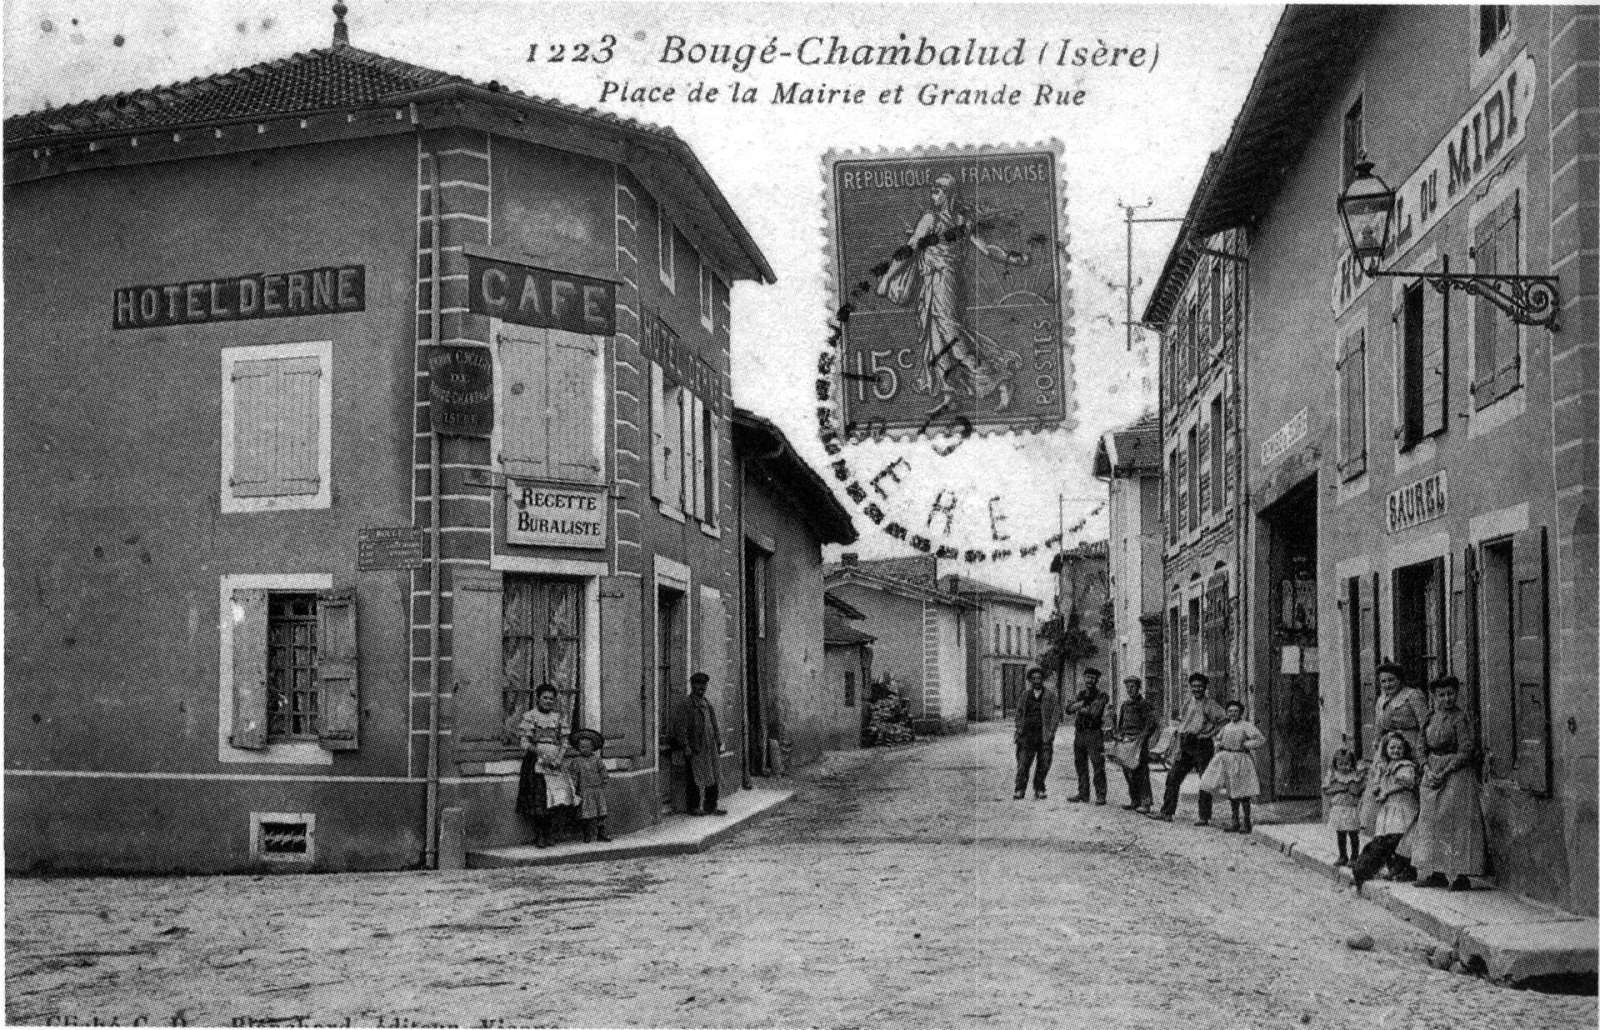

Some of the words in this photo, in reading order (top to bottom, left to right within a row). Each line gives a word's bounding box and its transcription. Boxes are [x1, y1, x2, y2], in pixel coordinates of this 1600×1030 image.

[1421, 167, 1438, 223] DU
[1448, 70, 1518, 198] MIDI
[117, 281, 228, 324] HOTEL
[239, 268, 358, 313] DERNE
[481, 268, 607, 328] CAFE
[1390, 475, 1446, 527] SAUREL
